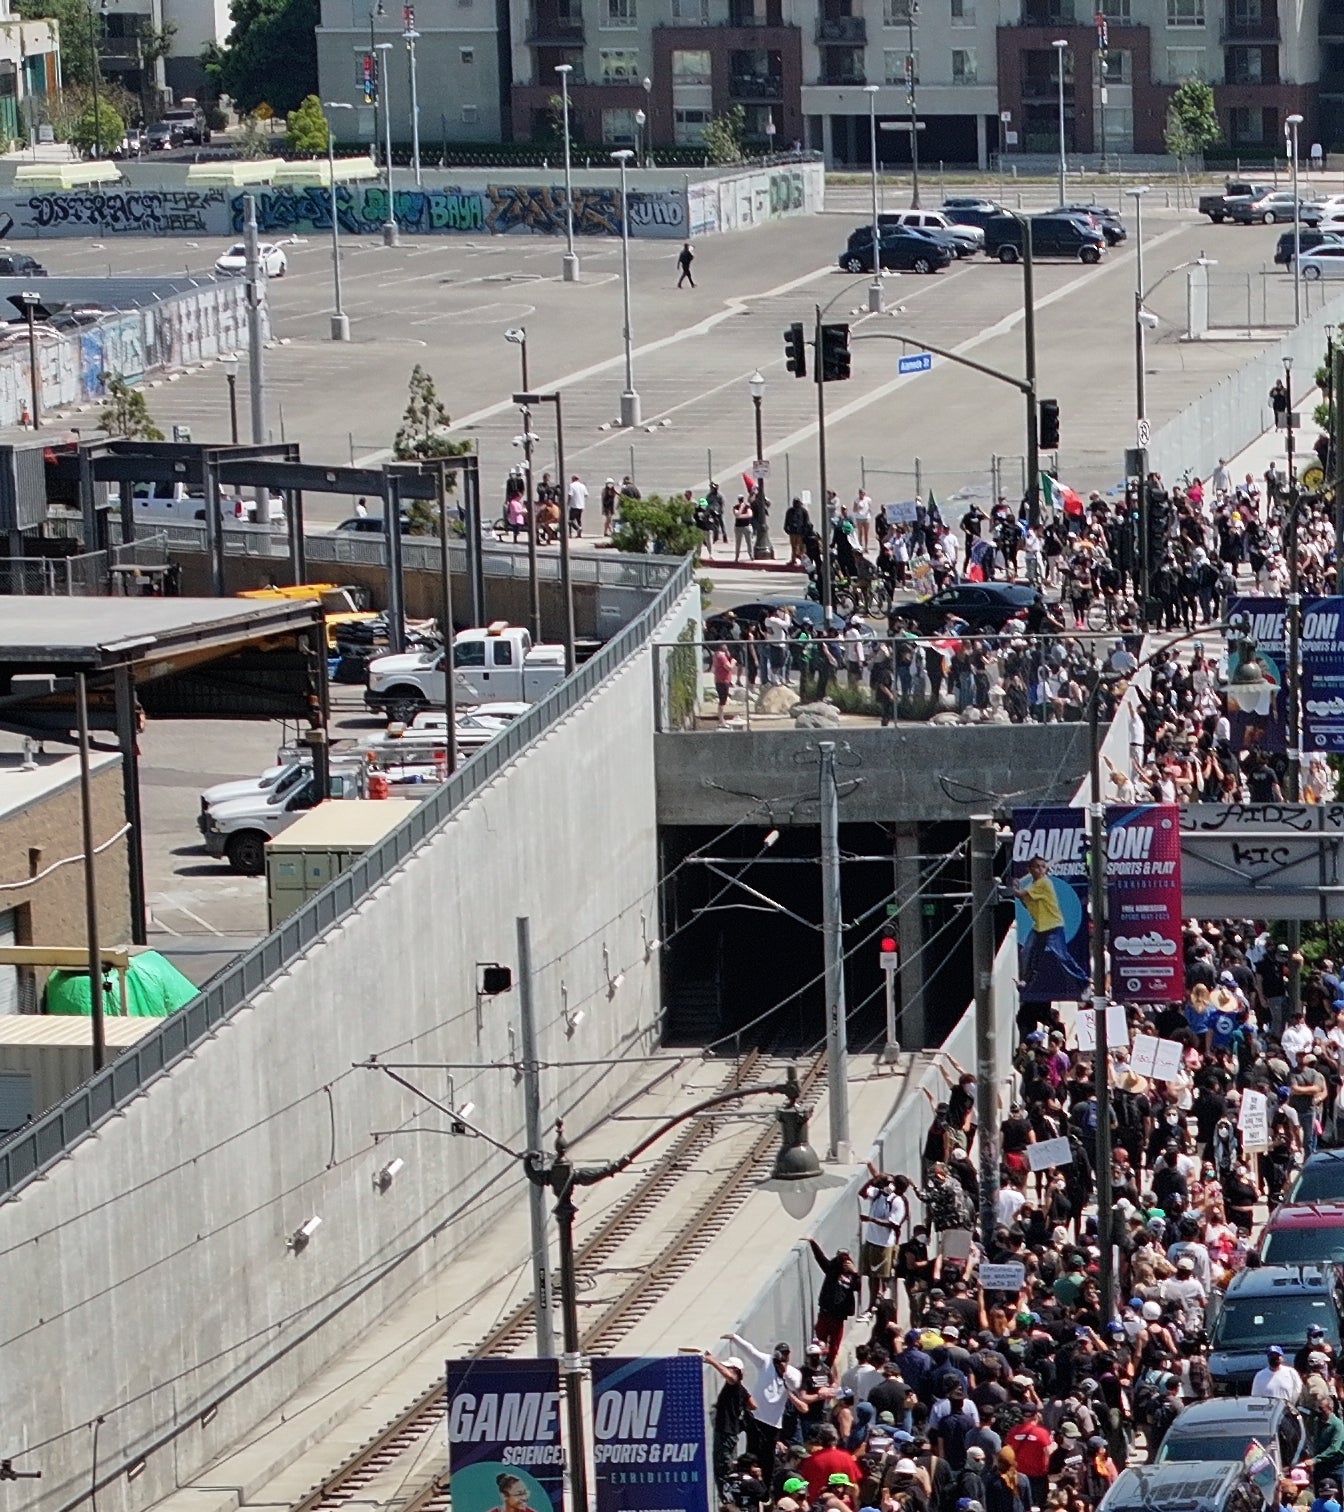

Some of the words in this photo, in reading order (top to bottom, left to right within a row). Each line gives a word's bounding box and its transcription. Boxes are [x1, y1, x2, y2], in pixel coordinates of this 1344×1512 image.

[1302, 613, 1340, 639] ON!
[1301, 641, 1331, 653] SPORTS
[1013, 827, 1087, 862] GAME
[1107, 826, 1153, 859] ON!
[1106, 862, 1141, 876] SPORTS
[1143, 862, 1150, 875] &
[1151, 862, 1176, 875] PLAY
[448, 1391, 561, 1443] GAME
[594, 1389, 664, 1440] ON!
[502, 1445, 565, 1466] SCIENCE,
[594, 1443, 648, 1463] SPORTS
[649, 1443, 661, 1462] &
[662, 1442, 699, 1462] PLAY
